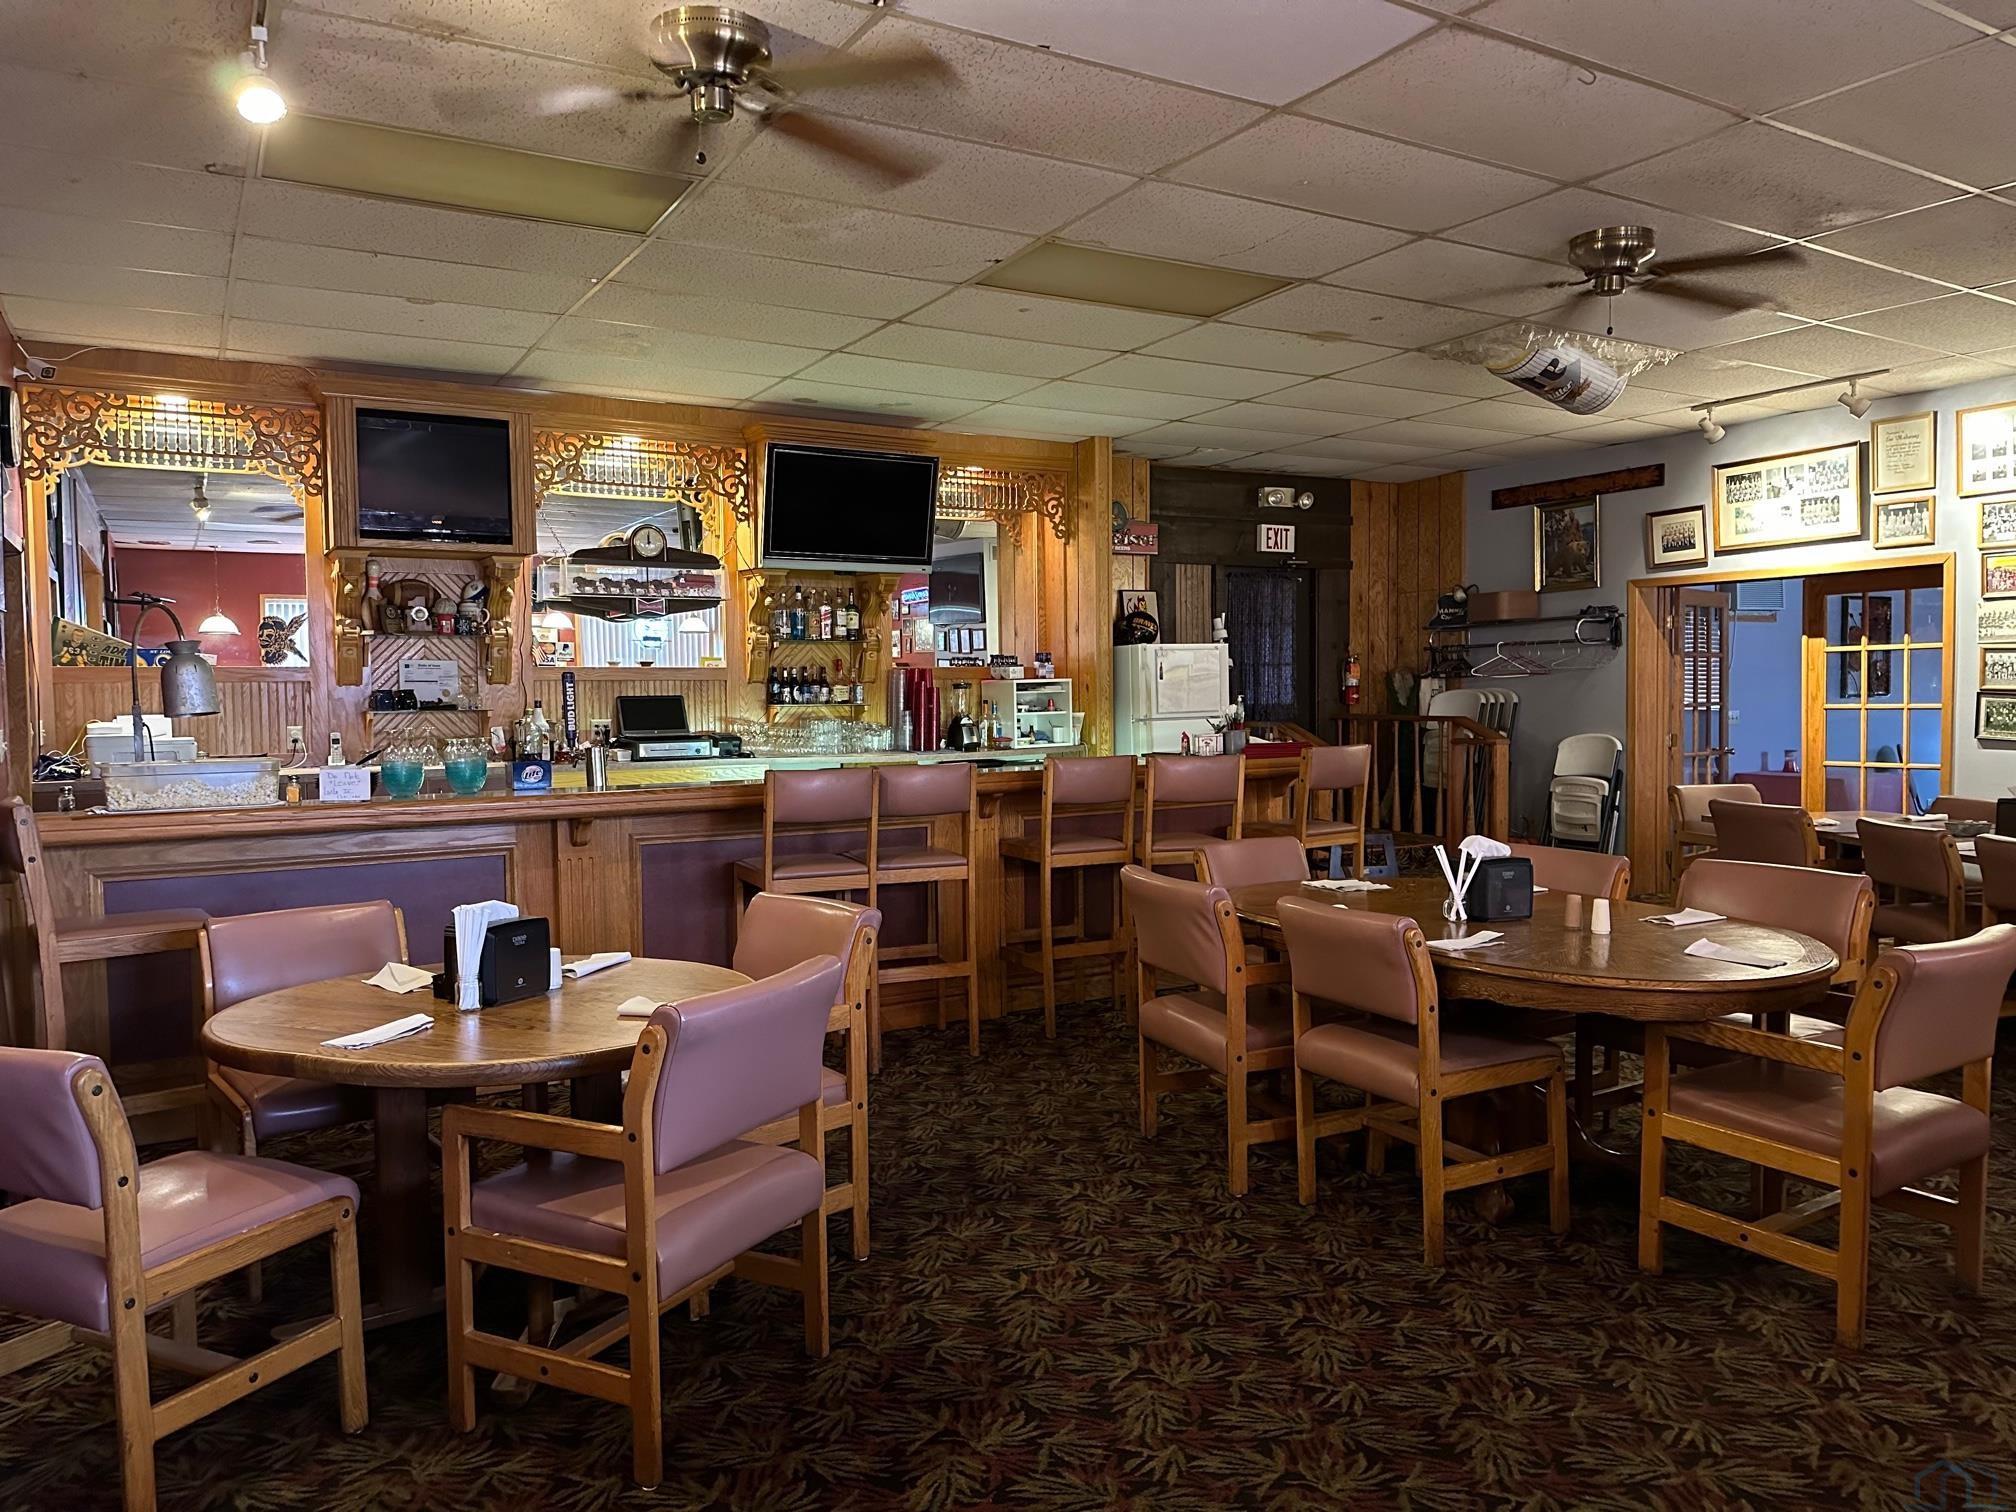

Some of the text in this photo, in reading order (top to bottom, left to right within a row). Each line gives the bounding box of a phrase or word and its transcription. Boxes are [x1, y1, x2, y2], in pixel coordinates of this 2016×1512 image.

[1266, 527, 1290, 550] EXIT
[565, 681, 576, 731] BUD LIGHT
